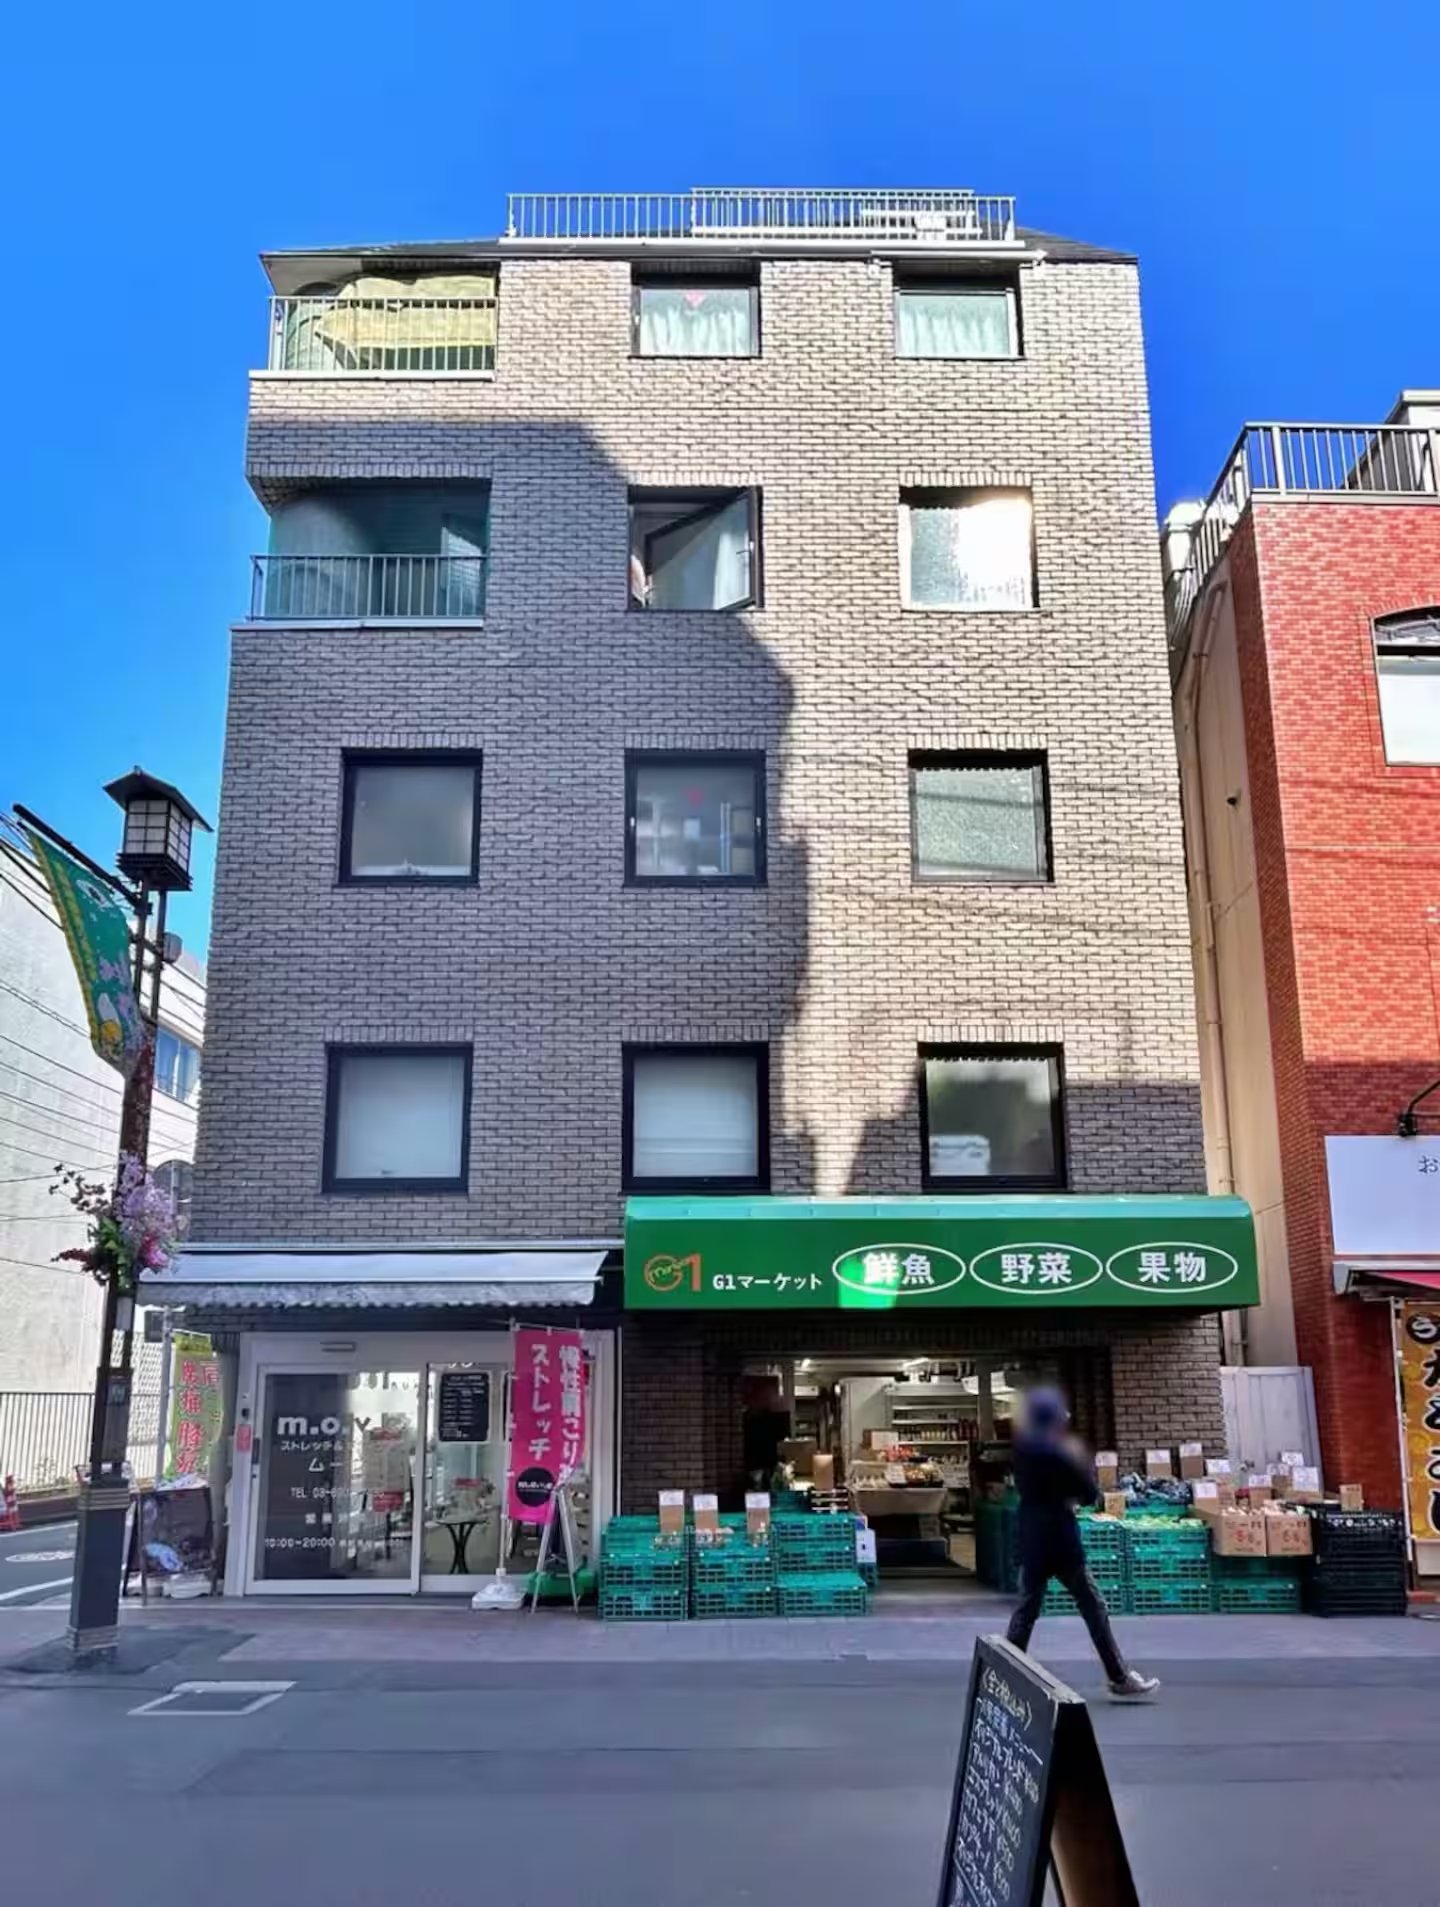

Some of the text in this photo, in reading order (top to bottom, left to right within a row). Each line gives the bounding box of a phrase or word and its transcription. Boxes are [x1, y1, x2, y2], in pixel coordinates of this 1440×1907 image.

[713, 1273, 823, 1291] G1マーケット
[863, 1252, 935, 1285] 鮮魚
[1000, 1252, 1072, 1285] 野菜
[1138, 1251, 1207, 1284] 果物
[529, 1343, 551, 1461] ストレッチ
[291, 1487, 307, 1498] TEL
